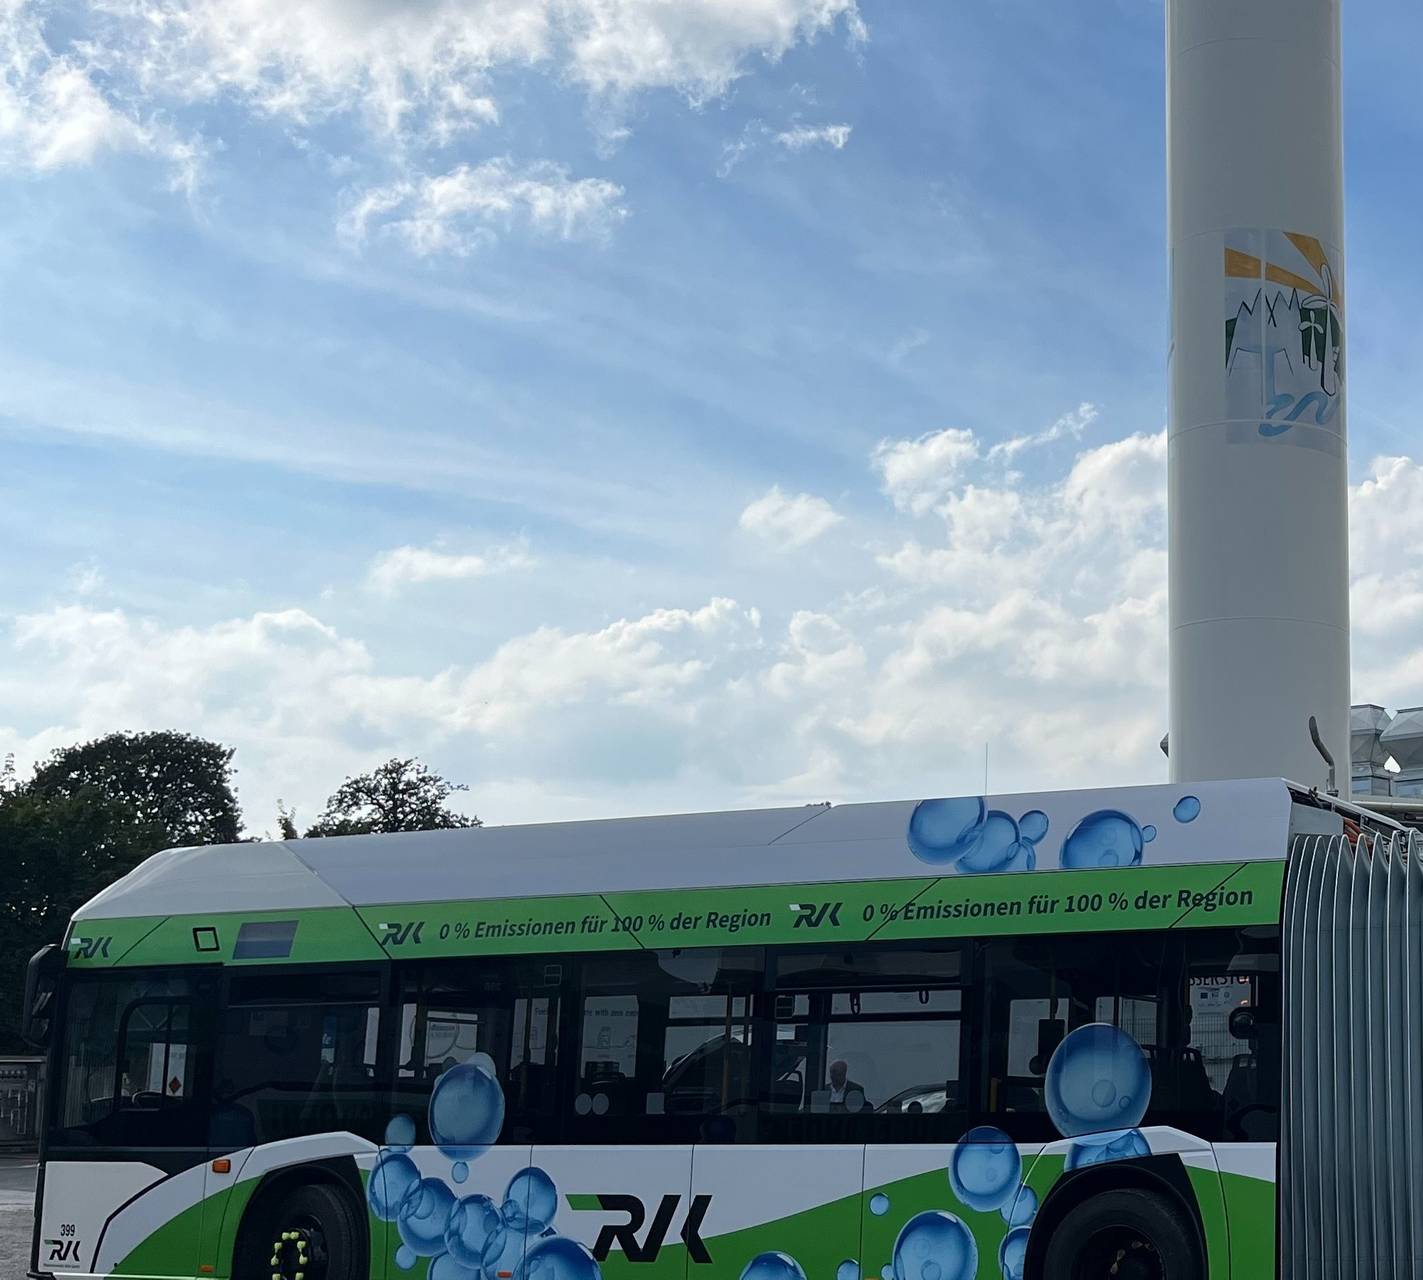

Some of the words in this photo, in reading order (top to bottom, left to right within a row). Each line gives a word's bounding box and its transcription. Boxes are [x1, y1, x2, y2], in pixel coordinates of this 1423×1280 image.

[862, 903, 875, 922] 0
[879, 902, 898, 921] %
[902, 897, 1023, 921] Emissionen
[1027, 893, 1060, 916] für
[1064, 893, 1103, 914] 100
[1108, 892, 1129, 912] %
[1133, 889, 1172, 911] der
[1176, 888, 1254, 912] Region
[439, 924, 450, 940] 0
[454, 922, 471, 939] %
[474, 918, 577, 939] Emissionen
[580, 914, 608, 934] für
[611, 915, 643, 933] 100
[648, 914, 665, 932] %
[669, 911, 701, 931] der
[705, 909, 772, 934] Region
[60, 1223, 76, 1237] 399
